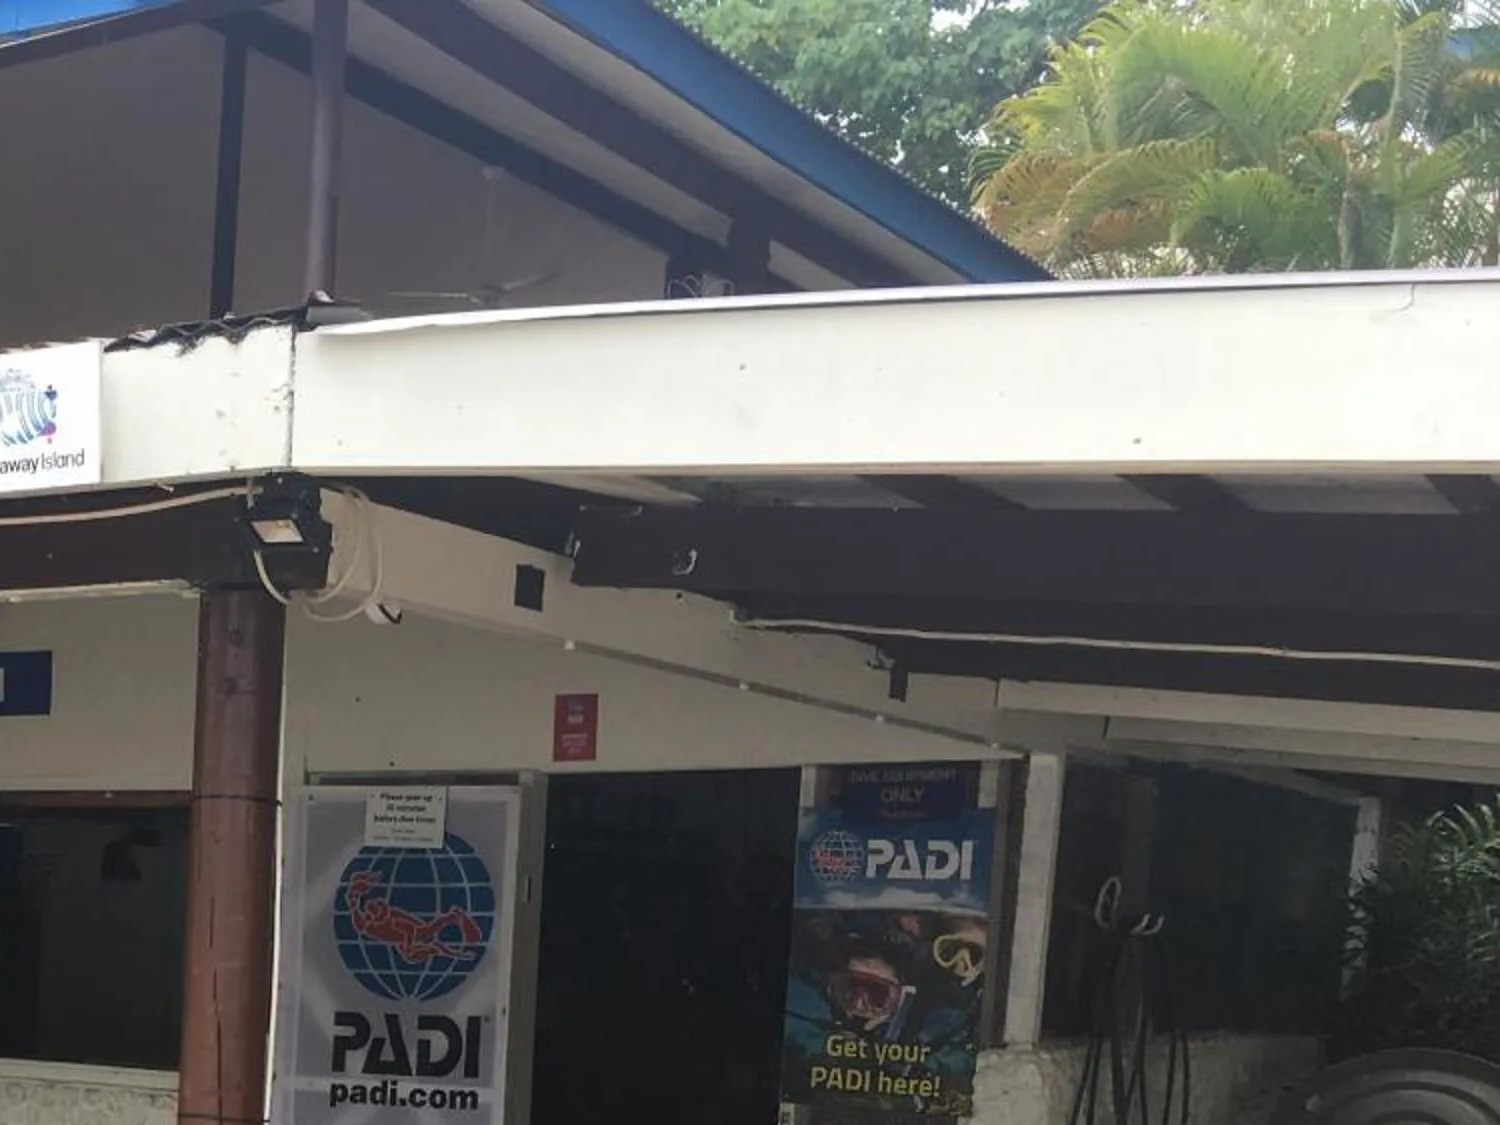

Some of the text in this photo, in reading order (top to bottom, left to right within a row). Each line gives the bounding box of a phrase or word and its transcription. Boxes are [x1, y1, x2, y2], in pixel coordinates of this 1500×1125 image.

[41, 448, 85, 470] Island
[880, 785, 925, 803] ONLY
[866, 839, 976, 882] PADI
[332, 1012, 481, 1079] PADI
[827, 1034, 931, 1067] Get your
[329, 1081, 480, 1110] padi.com
[811, 1067, 941, 1098] PADI here!
